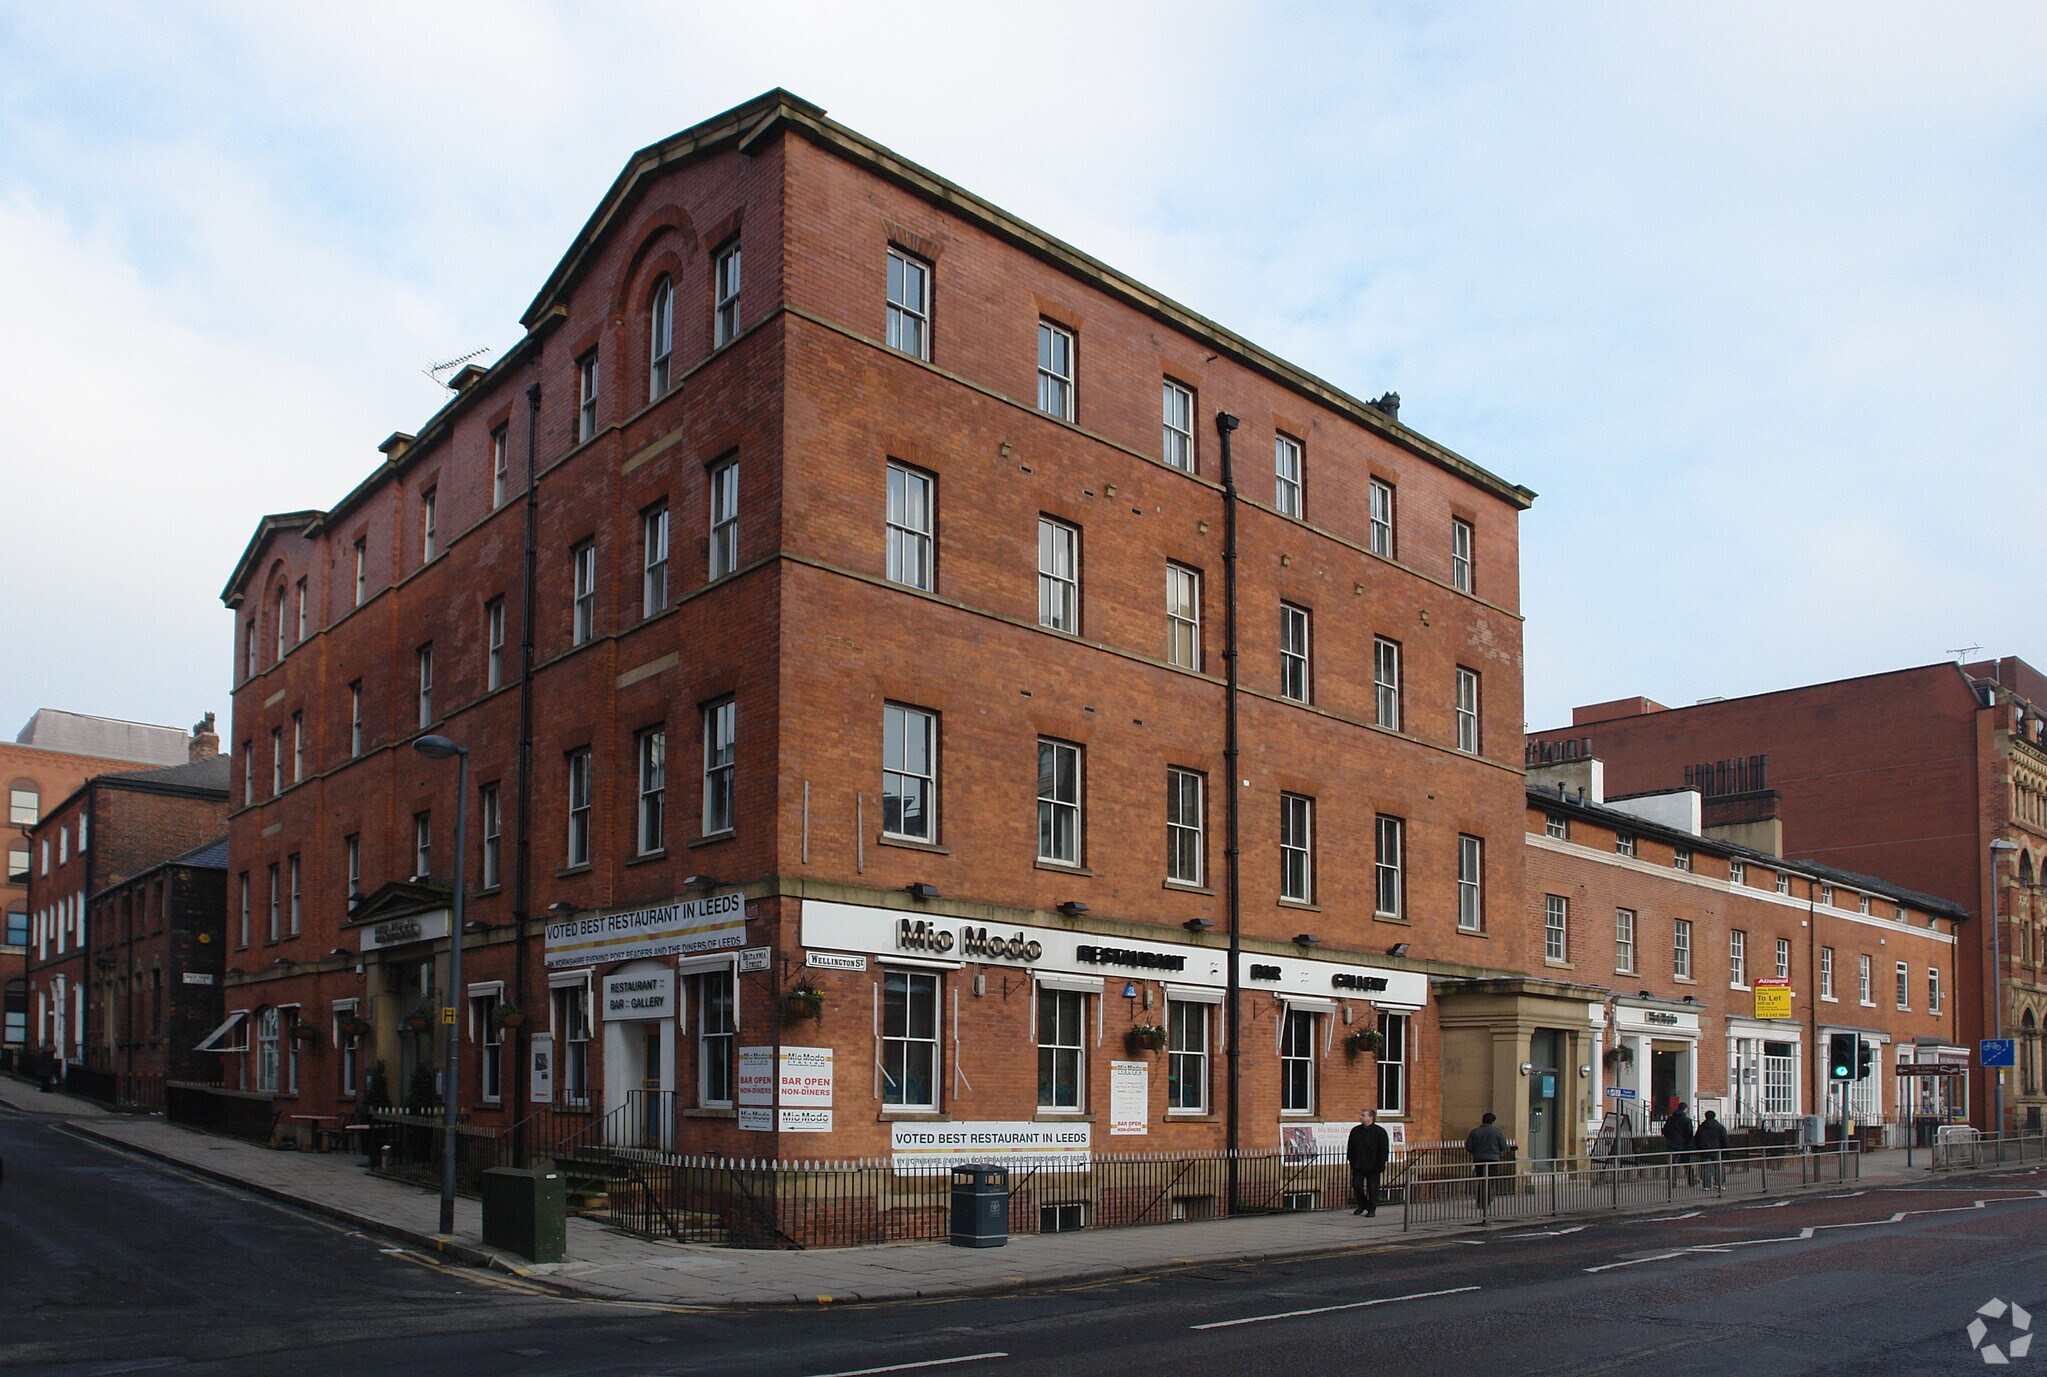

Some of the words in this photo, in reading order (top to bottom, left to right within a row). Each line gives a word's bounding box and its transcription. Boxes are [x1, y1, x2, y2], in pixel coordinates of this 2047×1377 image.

[547, 922, 577, 940] VOTED
[580, 918, 606, 935] BEST
[608, 905, 680, 931] RESTAURANT
[683, 902, 695, 919] IN
[699, 894, 740, 917] LEEDS
[896, 918, 954, 953] Mio
[959, 925, 1042, 962] Modo
[555, 957, 585, 967] YORKSHIRE
[586, 953, 609, 963] EVENING
[610, 951, 625, 960] POST
[626, 948, 652, 958] READERS
[654, 946, 666, 955] AND
[668, 945, 681, 954] THE
[682, 941, 706, 951] DINERS
[708, 939, 717, 949] OF
[718, 936, 740, 948] LEEDS
[742, 952, 766, 961] BRITANNIA
[745, 960, 762, 968] STREET
[811, 954, 855, 967] WELLINGTON
[1076, 945, 1188, 973] RESTAURANT
[610, 979, 657, 993] RESTAURANT
[610, 999, 624, 1010] BAR
[631, 996, 664, 1009] GALLERY
[803, 1053, 825, 1061] Modo
[740, 1076, 753, 1084] BAR
[754, 1076, 772, 1084] OPEN
[781, 1076, 802, 1085] BAR
[804, 1077, 830, 1086] OPEN
[740, 1087, 772, 1095] NON-DINERS
[781, 1088, 831, 1096] NON-DINERS
[740, 1111, 752, 1119] Mio
[752, 1111, 770, 1120] Modo
[782, 1111, 800, 1121] Mio
[802, 1112, 829, 1122] Modo
[896, 1133, 935, 1144] VOTED
[938, 1133, 967, 1144] BEST
[970, 1132, 1041, 1144] RESTAURANT
[1042, 1132, 1053, 1143] IN
[1055, 1132, 1087, 1143] LEEDS
